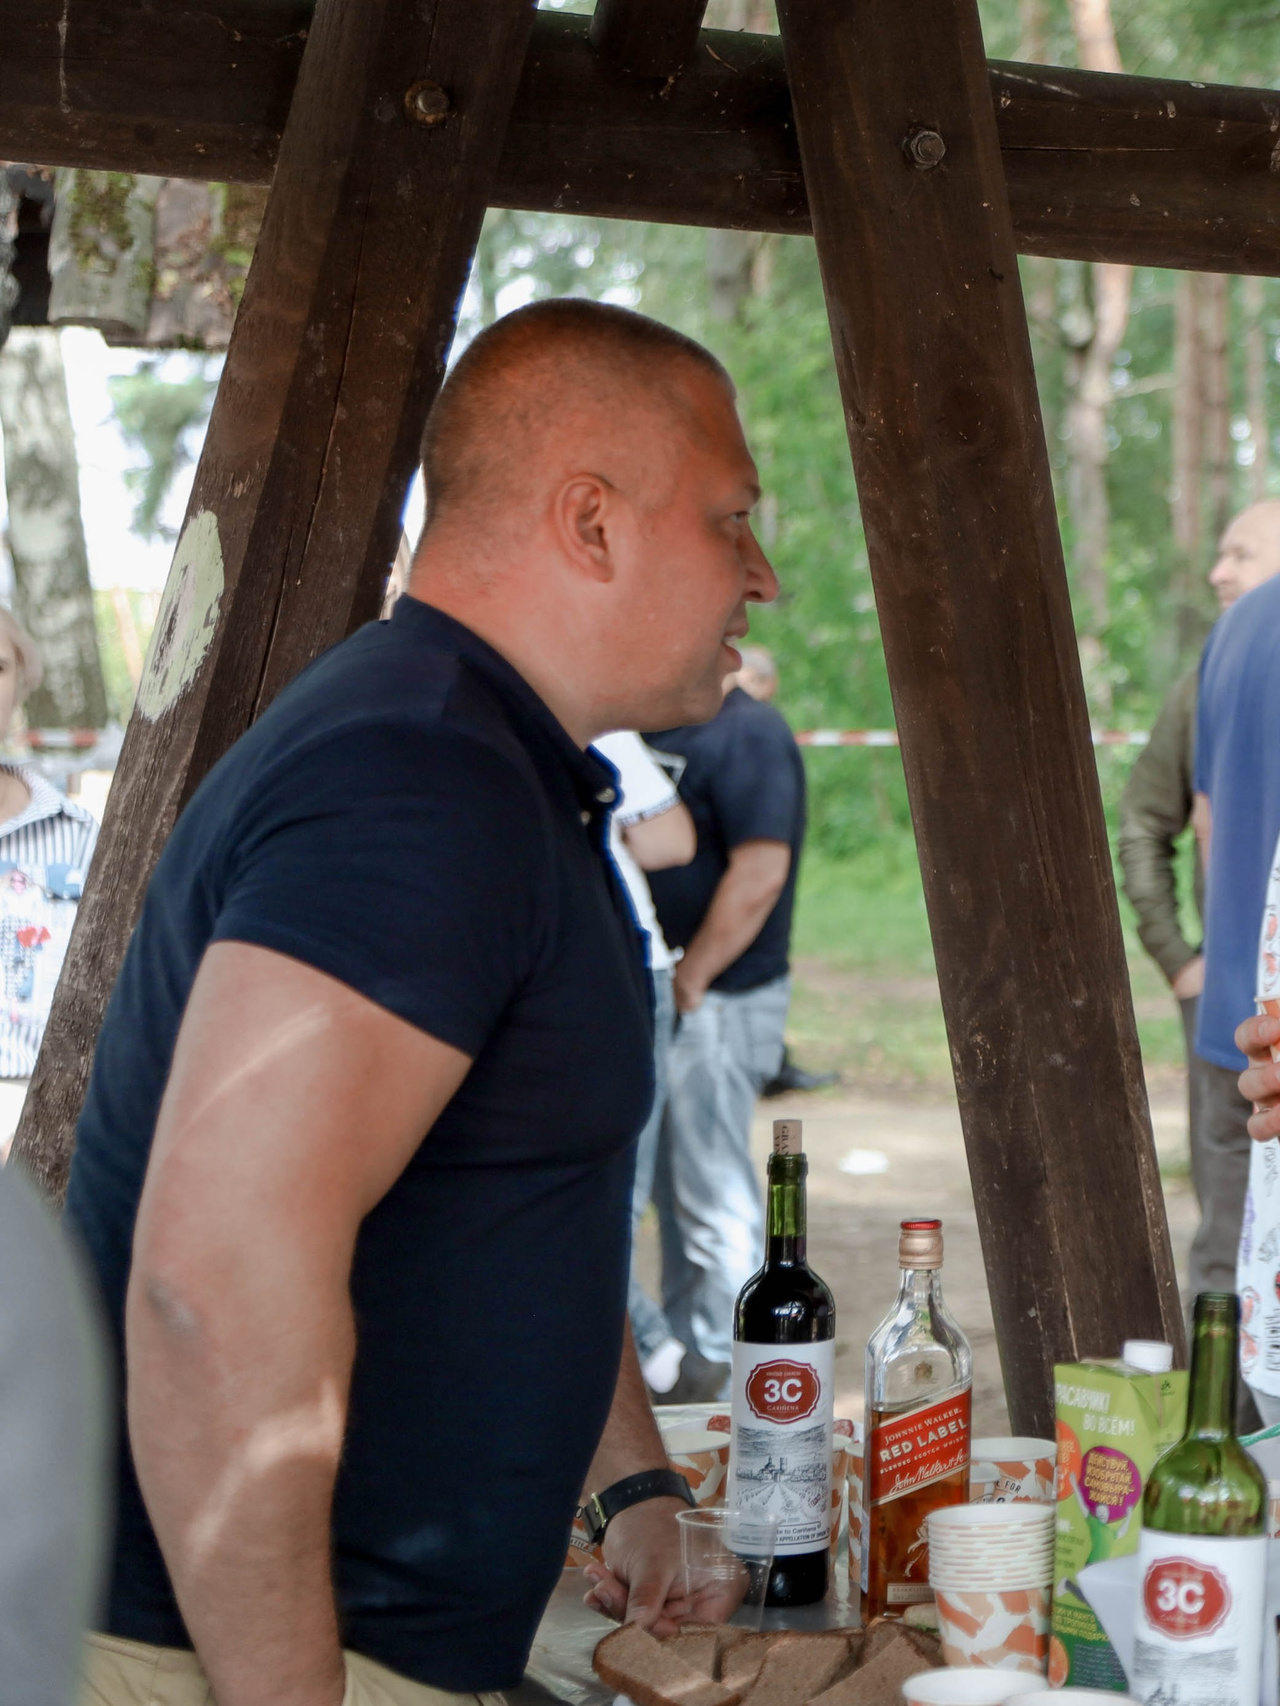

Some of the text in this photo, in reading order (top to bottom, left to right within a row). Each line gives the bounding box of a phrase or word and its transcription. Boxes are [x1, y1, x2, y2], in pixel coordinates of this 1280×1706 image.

[763, 1378, 802, 1403] 3C
[1055, 1384, 1111, 1414] РАСАВЧИК!
[885, 1424, 923, 1445] JOHNNIE
[1083, 1414, 1136, 1437] ВО ВСЁМ!
[880, 1418, 968, 1463] RED LABEL
[880, 1460, 911, 1474] BLENDED
[914, 1446, 940, 1461] SCOTCH
[1005, 1481, 1021, 1493] FOR
[1156, 1577, 1206, 1614] 3C
